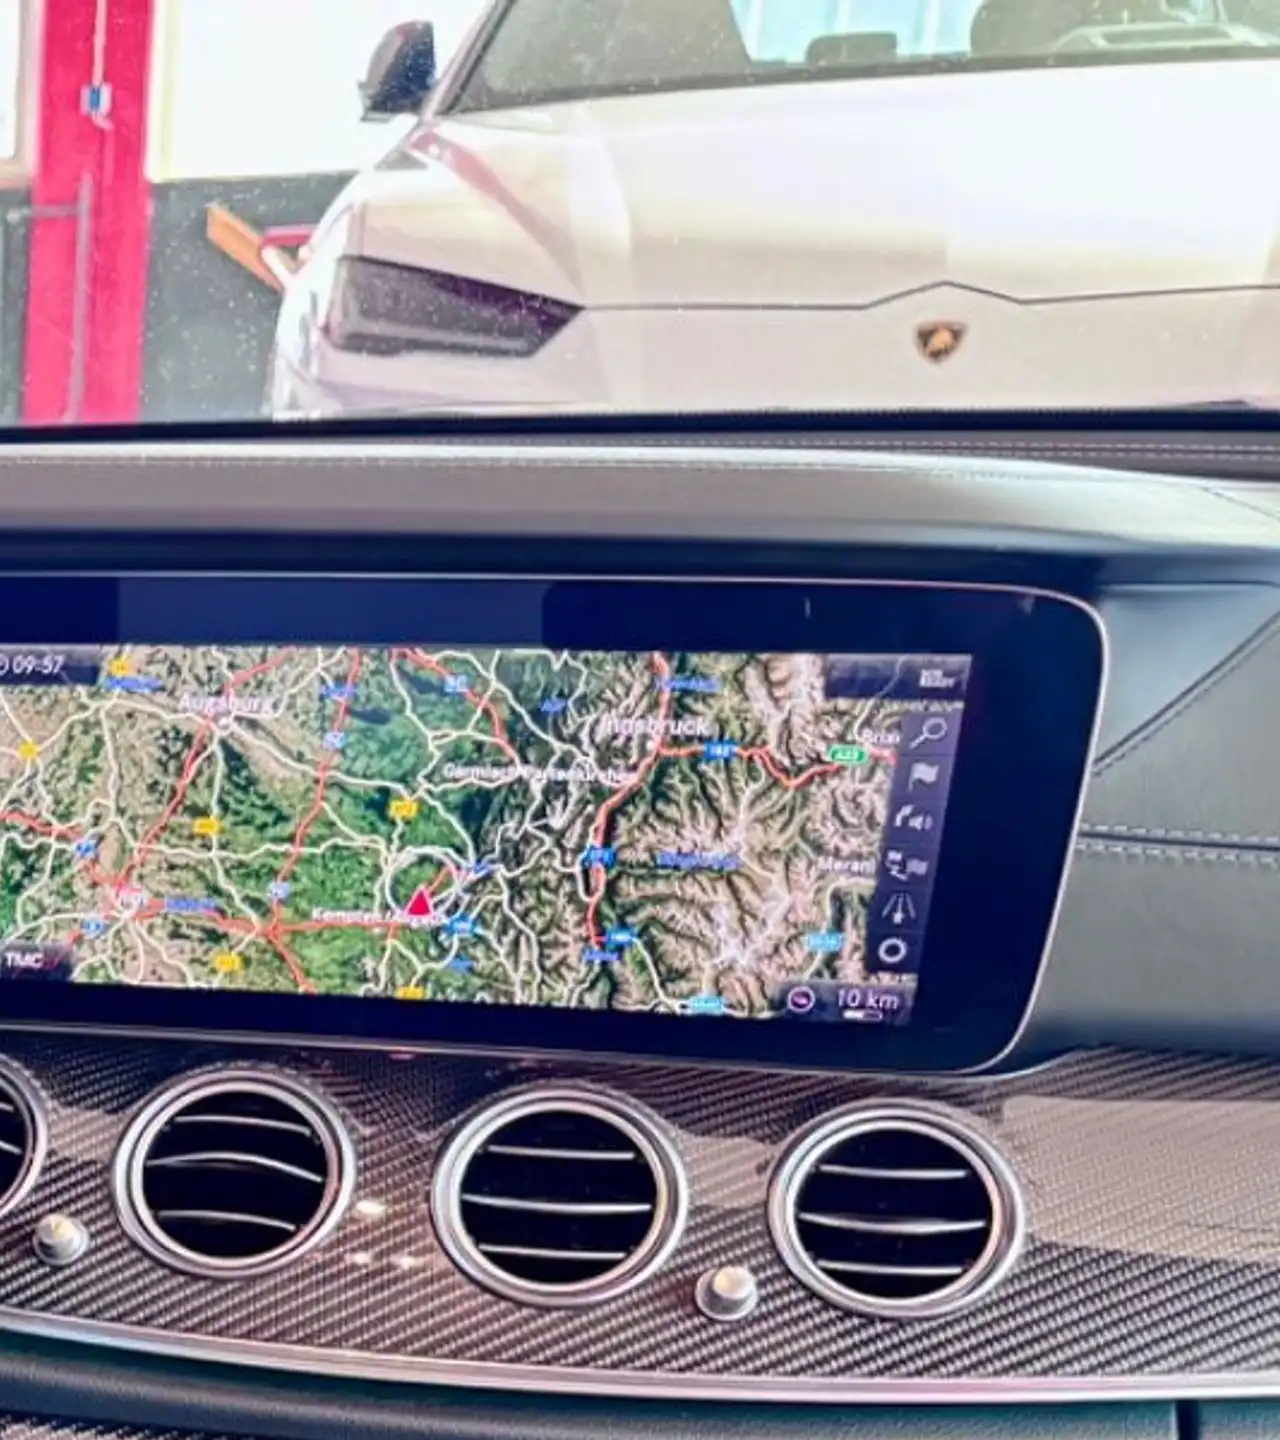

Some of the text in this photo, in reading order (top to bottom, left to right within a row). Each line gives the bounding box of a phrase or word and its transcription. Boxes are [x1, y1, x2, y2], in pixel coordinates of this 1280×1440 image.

[12, 655, 64, 674] 09:57
[839, 990, 900, 1010] 10 km
